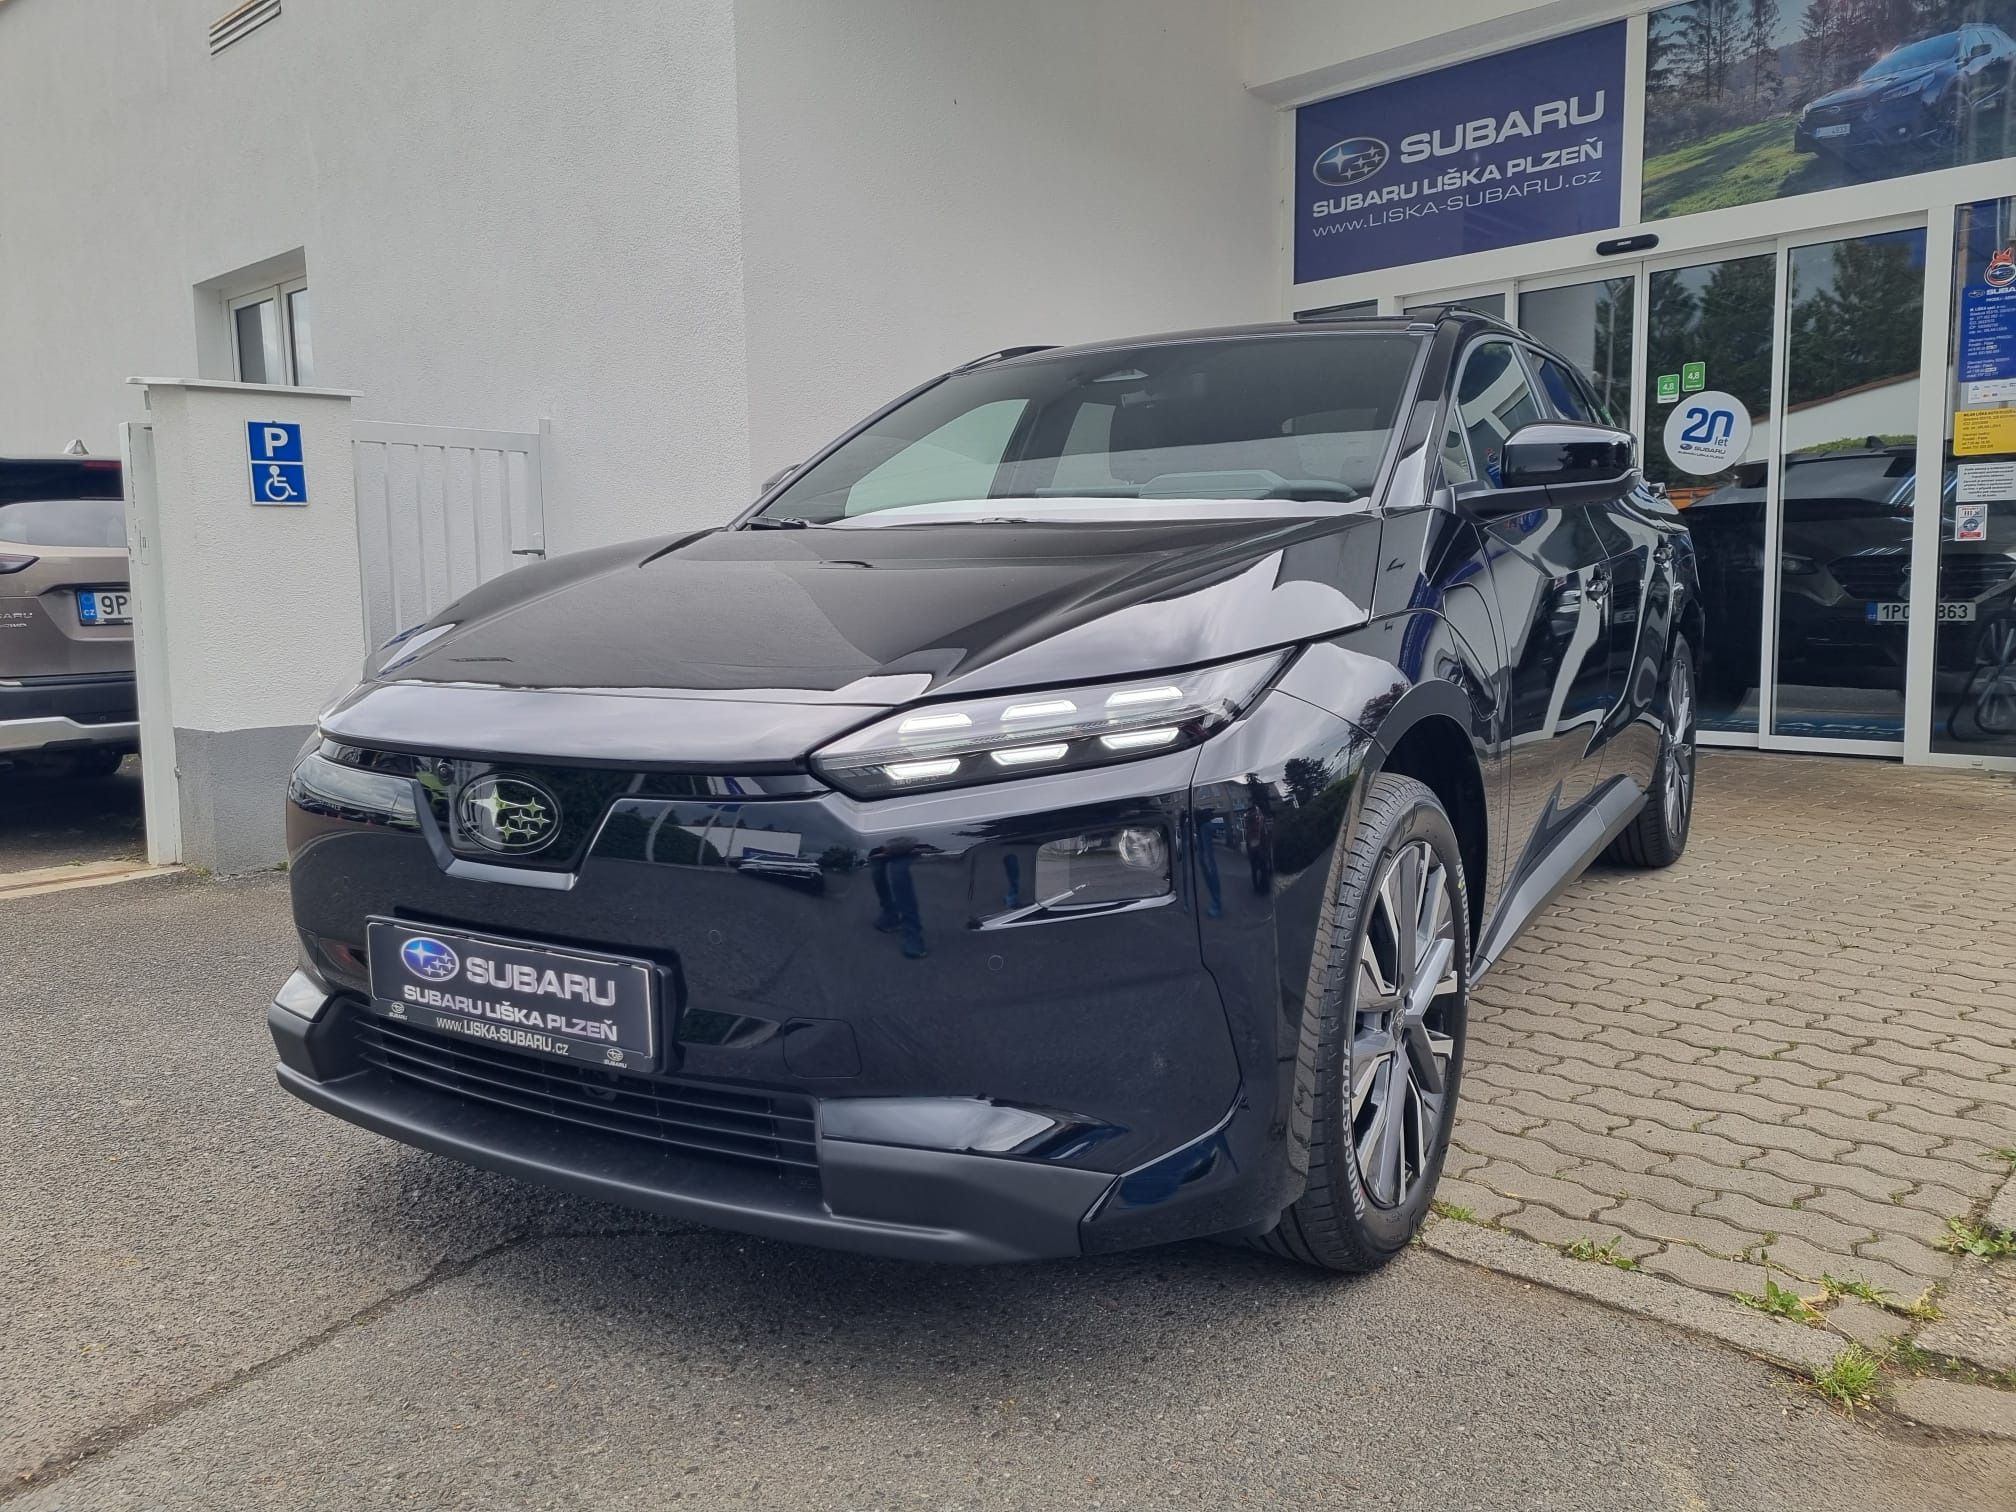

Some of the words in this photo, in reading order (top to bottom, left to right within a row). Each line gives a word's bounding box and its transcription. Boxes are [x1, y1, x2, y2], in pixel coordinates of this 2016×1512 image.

[1400, 90, 1606, 164] SUBARU
[1313, 181, 1419, 218] SUBARU
[1423, 168, 1502, 196] LIŠKA
[1507, 137, 1603, 178] PLZEŇ
[1312, 170, 1602, 238] www.LISKA-SUBARU.cz
[263, 427, 288, 457] P
[1681, 407, 1734, 443] 20
[1714, 436, 1728, 447] let
[1694, 445, 1726, 455] SUBARU
[84, 608, 96, 616] CZ
[101, 595, 128, 615] 9P
[466, 956, 616, 1007] SUBARU
[403, 985, 482, 1015] SUBARU
[485, 1001, 544, 1029] LIŠKA
[547, 1014, 617, 1042] PLZEŇ
